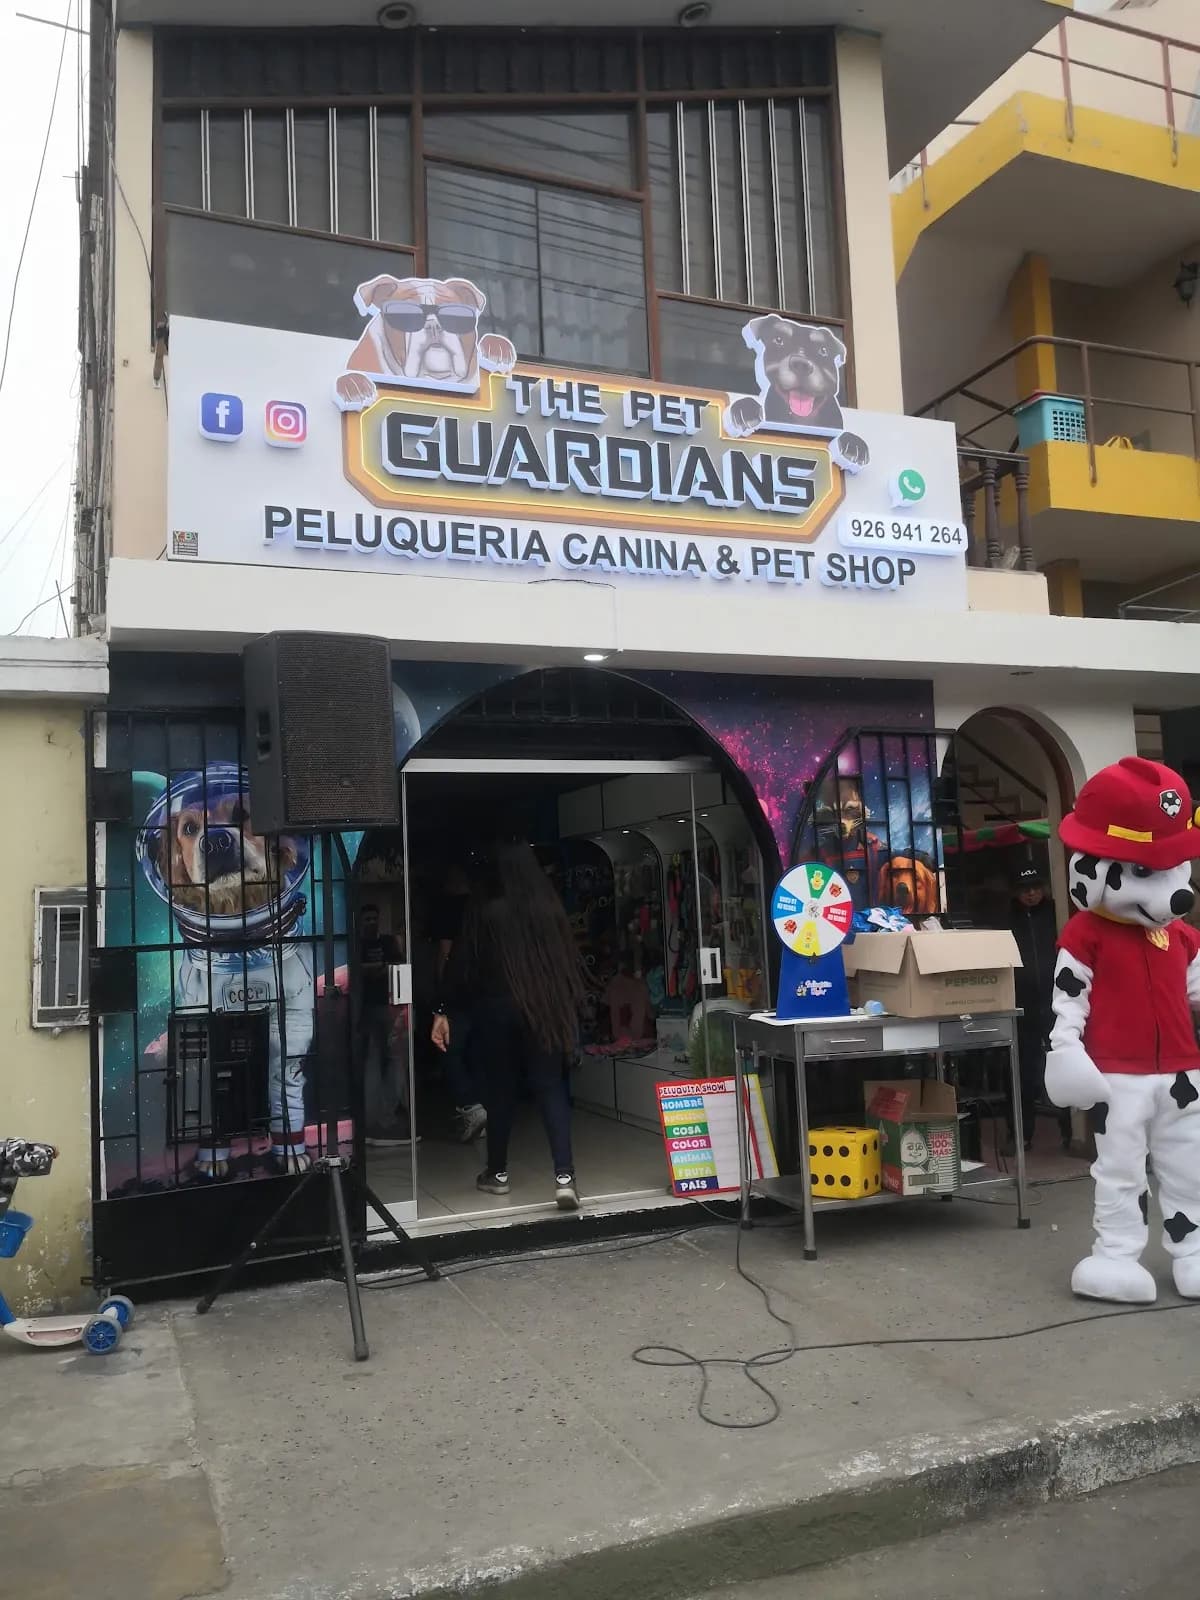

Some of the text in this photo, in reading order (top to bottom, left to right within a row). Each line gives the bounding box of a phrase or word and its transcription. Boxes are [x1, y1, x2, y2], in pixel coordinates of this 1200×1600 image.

[507, 373, 710, 436] THE PET
[383, 410, 818, 517] GUARDIANS
[851, 518, 963, 546] 926 941 264
[263, 504, 917, 586] PELUQUERIA CANINA & PET SHOP
[944, 975, 998, 988] PEPSICO
[661, 1098, 703, 1111] NOMBRE
[672, 1125, 702, 1136] COSA
[672, 1139, 707, 1150] COLOR
